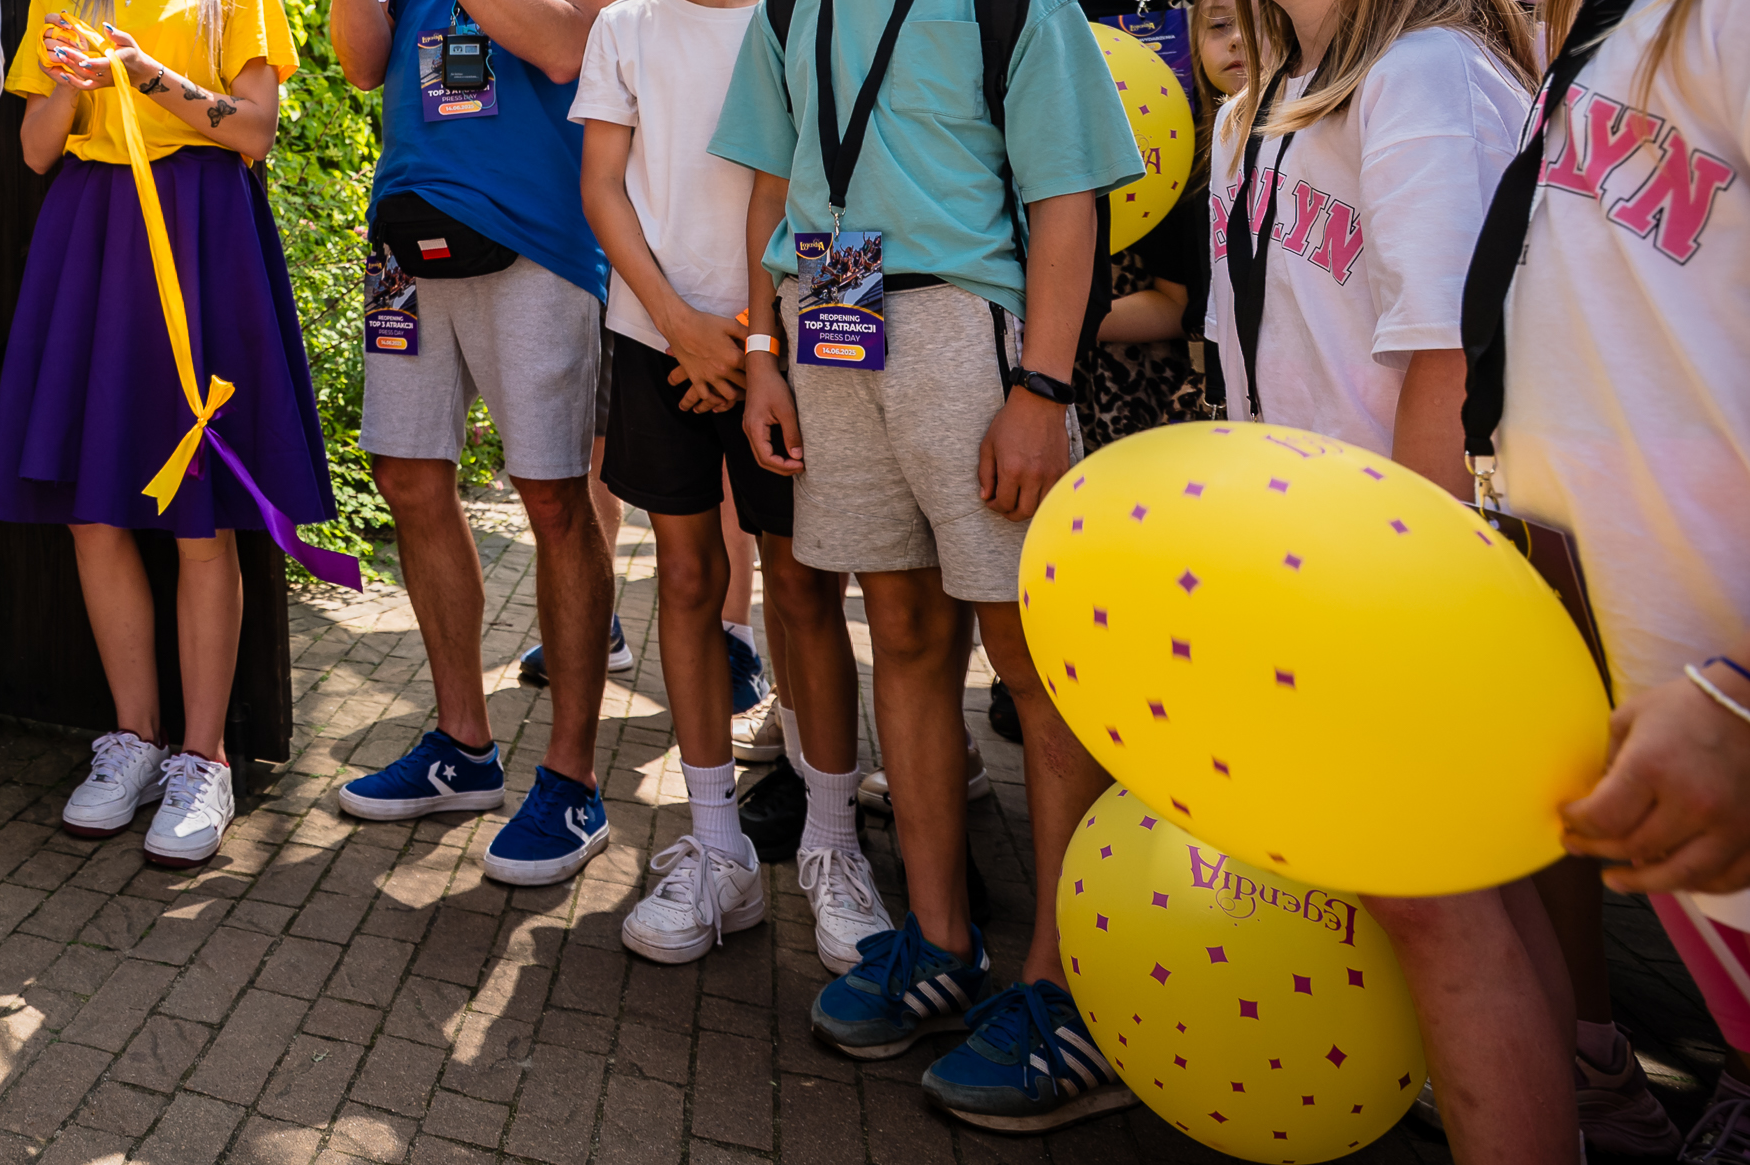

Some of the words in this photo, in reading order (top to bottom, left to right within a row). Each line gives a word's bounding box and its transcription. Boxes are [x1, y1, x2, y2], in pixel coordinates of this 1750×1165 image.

[819, 313, 860, 322] REOPENING
[804, 321, 823, 330] TOP
[824, 322, 830, 330] 3
[831, 322, 876, 333] ATRAKCJI
[819, 333, 843, 341] PRESS
[844, 334, 860, 342] DAY
[822, 347, 857, 356] 14.06.2025
